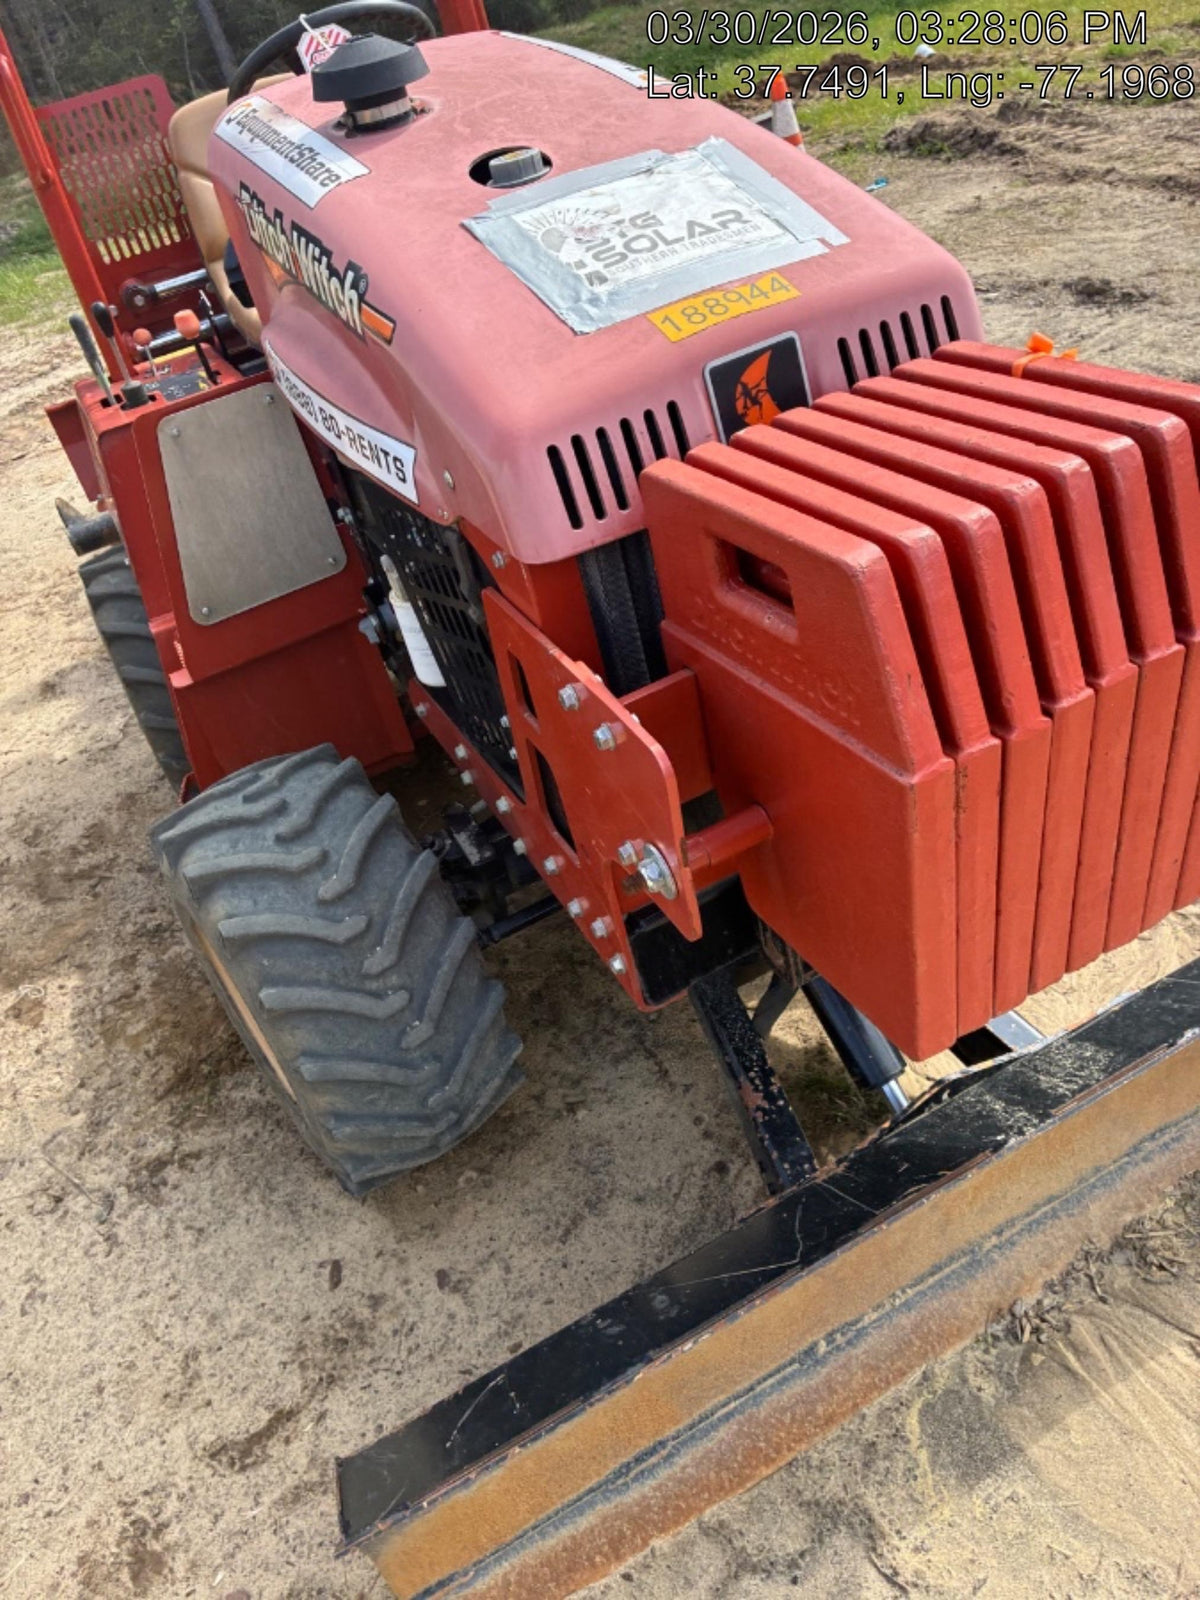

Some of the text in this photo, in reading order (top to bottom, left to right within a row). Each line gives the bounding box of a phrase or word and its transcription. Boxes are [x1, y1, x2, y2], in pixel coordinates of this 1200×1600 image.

[236, 108, 342, 188] EquipmentShare
[591, 209, 752, 269] SOLAR
[683, 222, 762, 253] TRADESMEN
[660, 276, 791, 332] 188944
